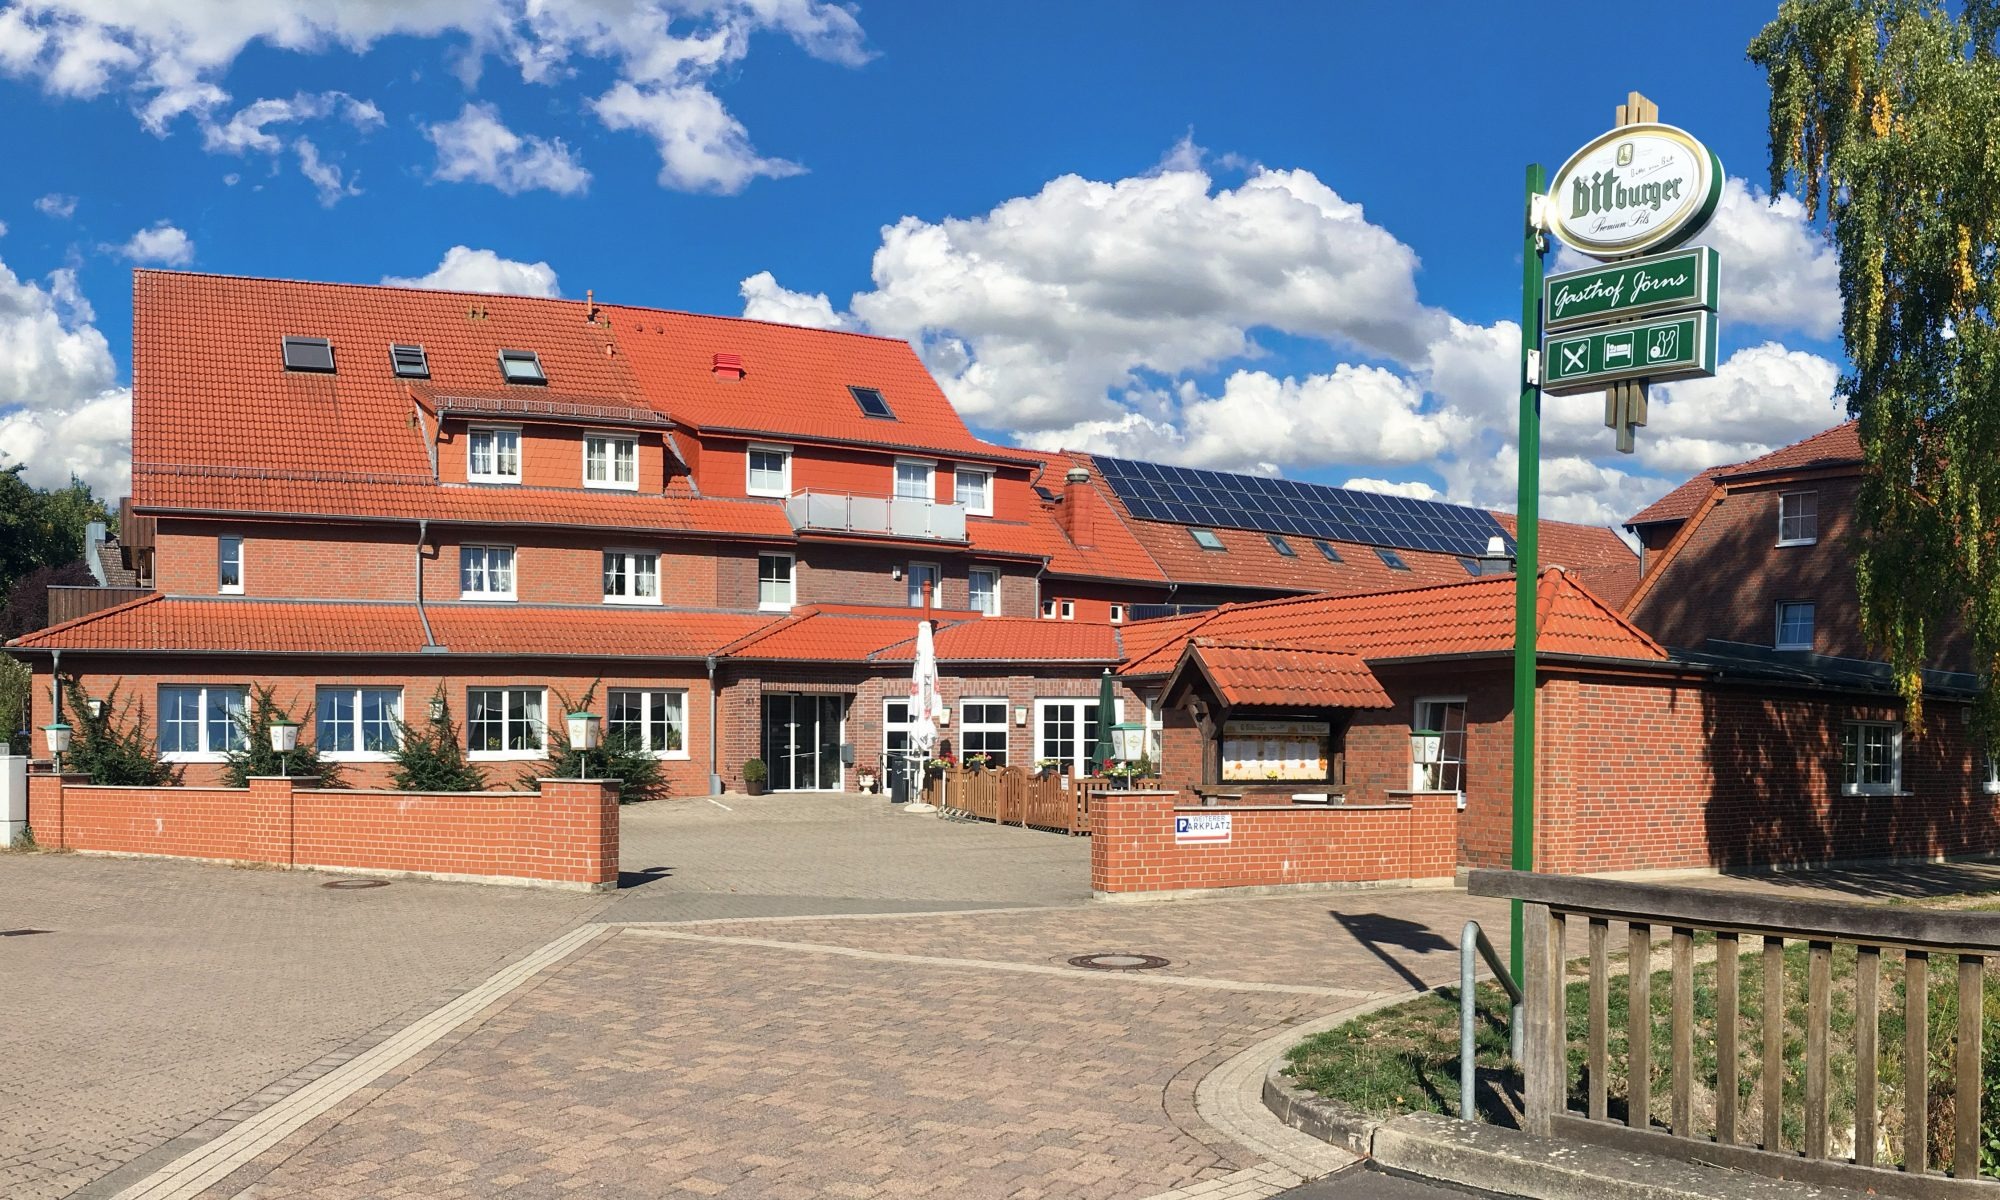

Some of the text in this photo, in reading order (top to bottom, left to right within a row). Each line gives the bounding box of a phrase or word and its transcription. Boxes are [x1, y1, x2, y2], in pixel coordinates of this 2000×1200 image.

[1570, 168, 1682, 219] bitburger
[1589, 209, 1650, 234] Premium Pils
[1554, 270, 1688, 316] Gasthof Jörns
[1179, 820, 1231, 831] PARKPLATZ
